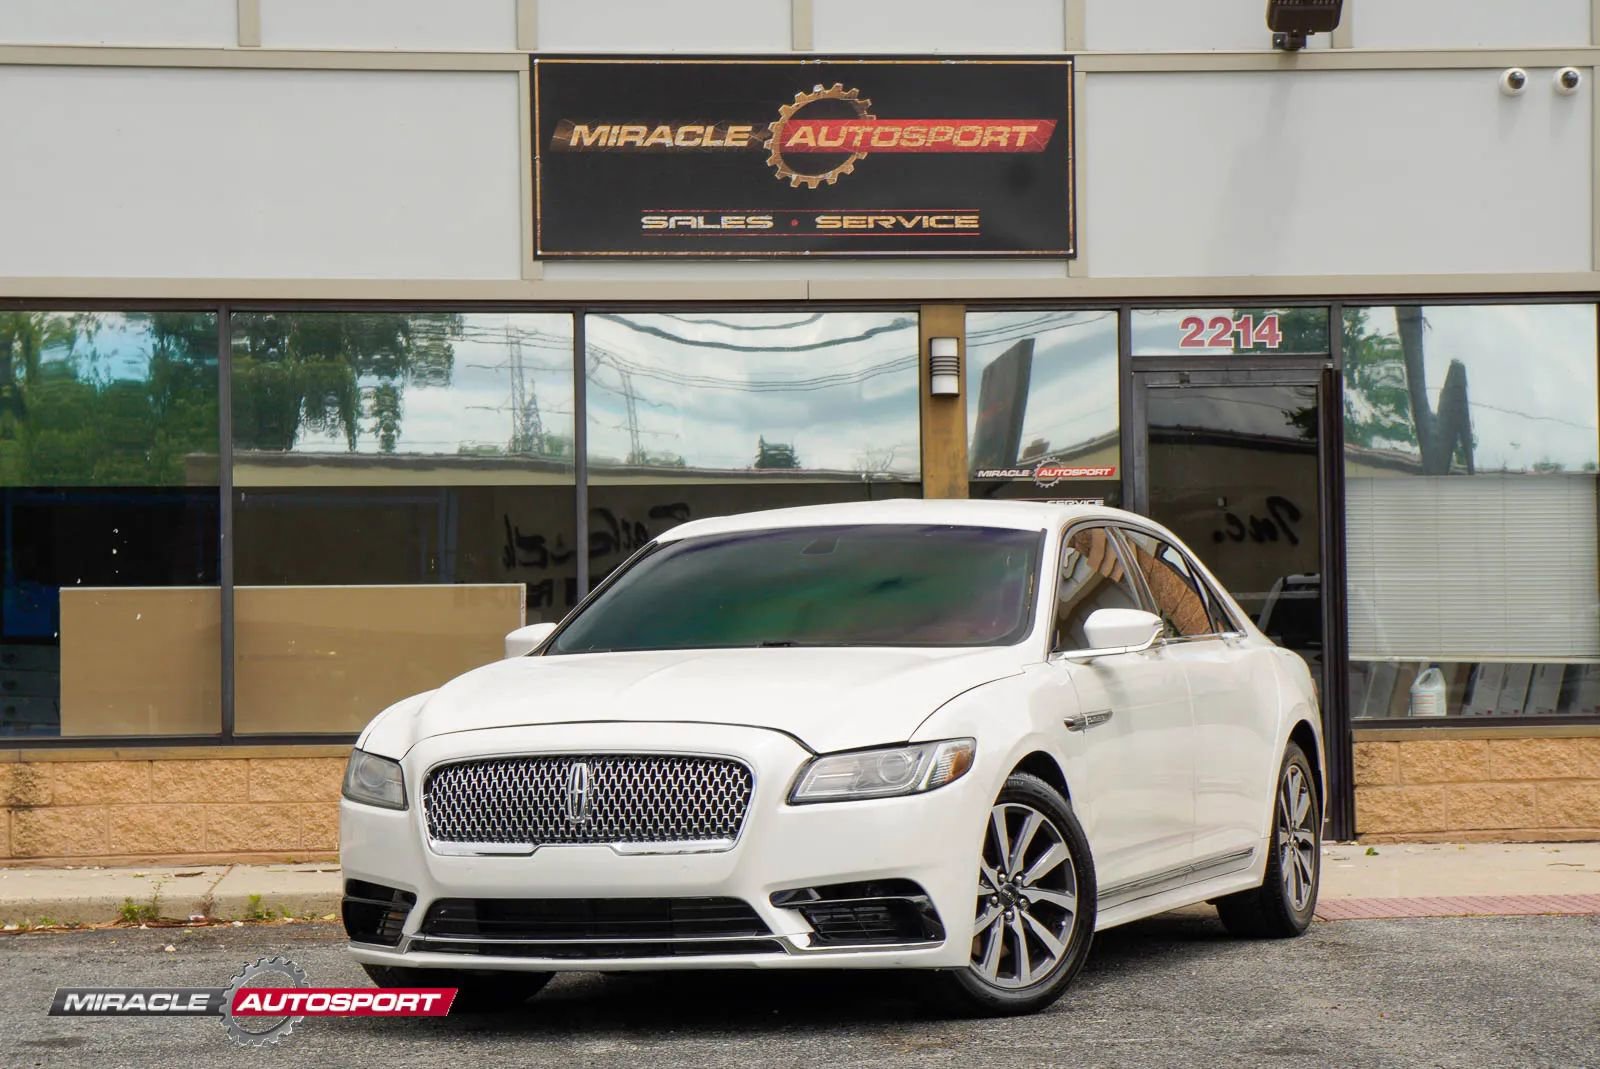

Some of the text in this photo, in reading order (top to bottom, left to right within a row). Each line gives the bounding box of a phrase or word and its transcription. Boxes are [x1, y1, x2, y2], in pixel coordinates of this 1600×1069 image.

[570, 124, 1039, 147] MIRACLE AUTOSPORT
[641, 215, 980, 230] SALES SERVICE
[1179, 315, 1282, 348] 2214
[977, 468, 1112, 478] MIRACLE AUTOSPORT
